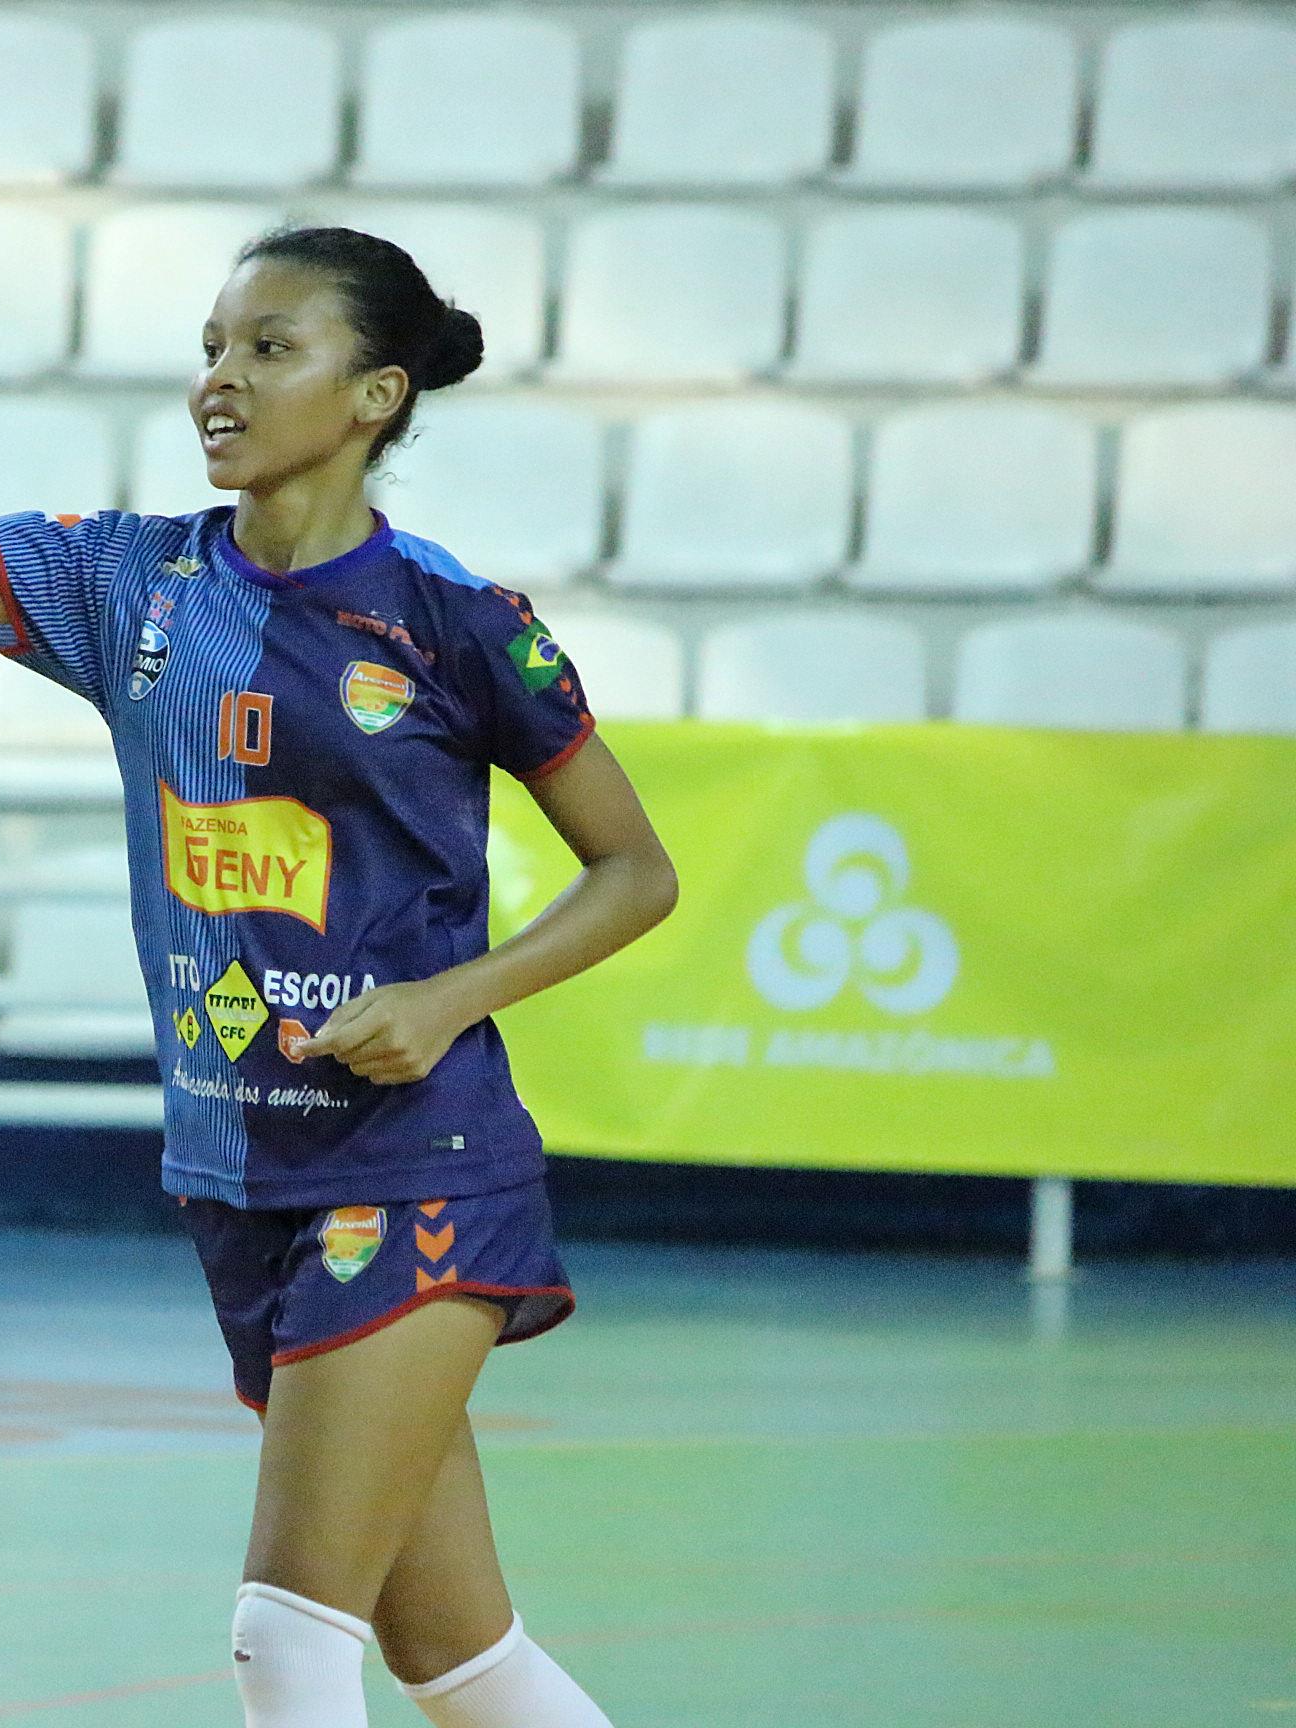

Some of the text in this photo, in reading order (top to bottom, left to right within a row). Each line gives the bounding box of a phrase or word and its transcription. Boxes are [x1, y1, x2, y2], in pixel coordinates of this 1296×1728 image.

[218, 689, 274, 767] 10
[185, 835, 307, 898] GENY
[220, 1025, 246, 1041] CFC
